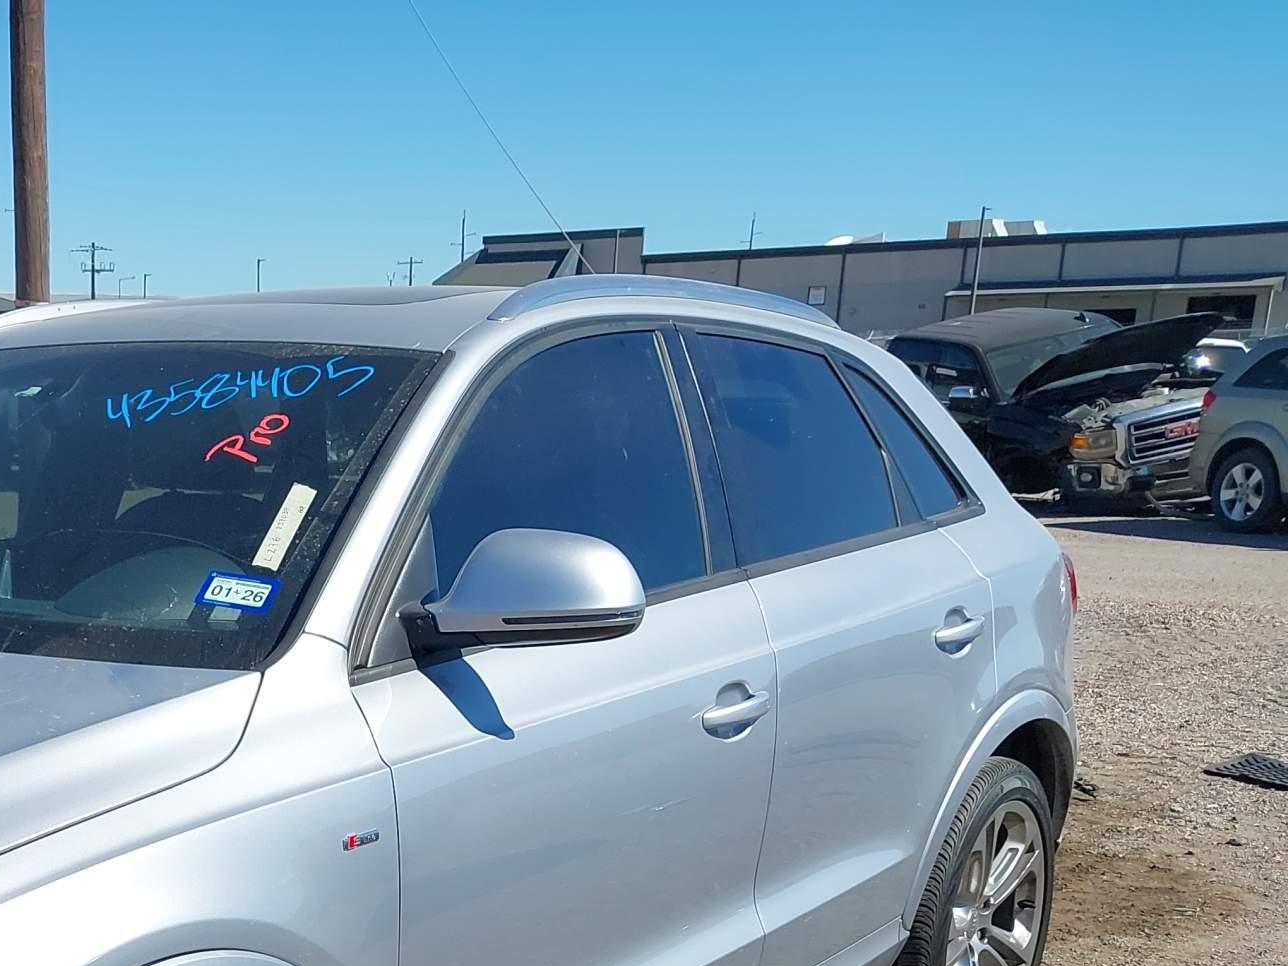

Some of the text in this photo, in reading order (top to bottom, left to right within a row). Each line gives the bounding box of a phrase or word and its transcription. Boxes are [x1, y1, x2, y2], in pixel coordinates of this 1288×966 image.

[107, 356, 374, 428] 43584405
[1164, 417, 1200, 438] GM
[210, 584, 233, 598] 01
[240, 589, 265, 603] 26
